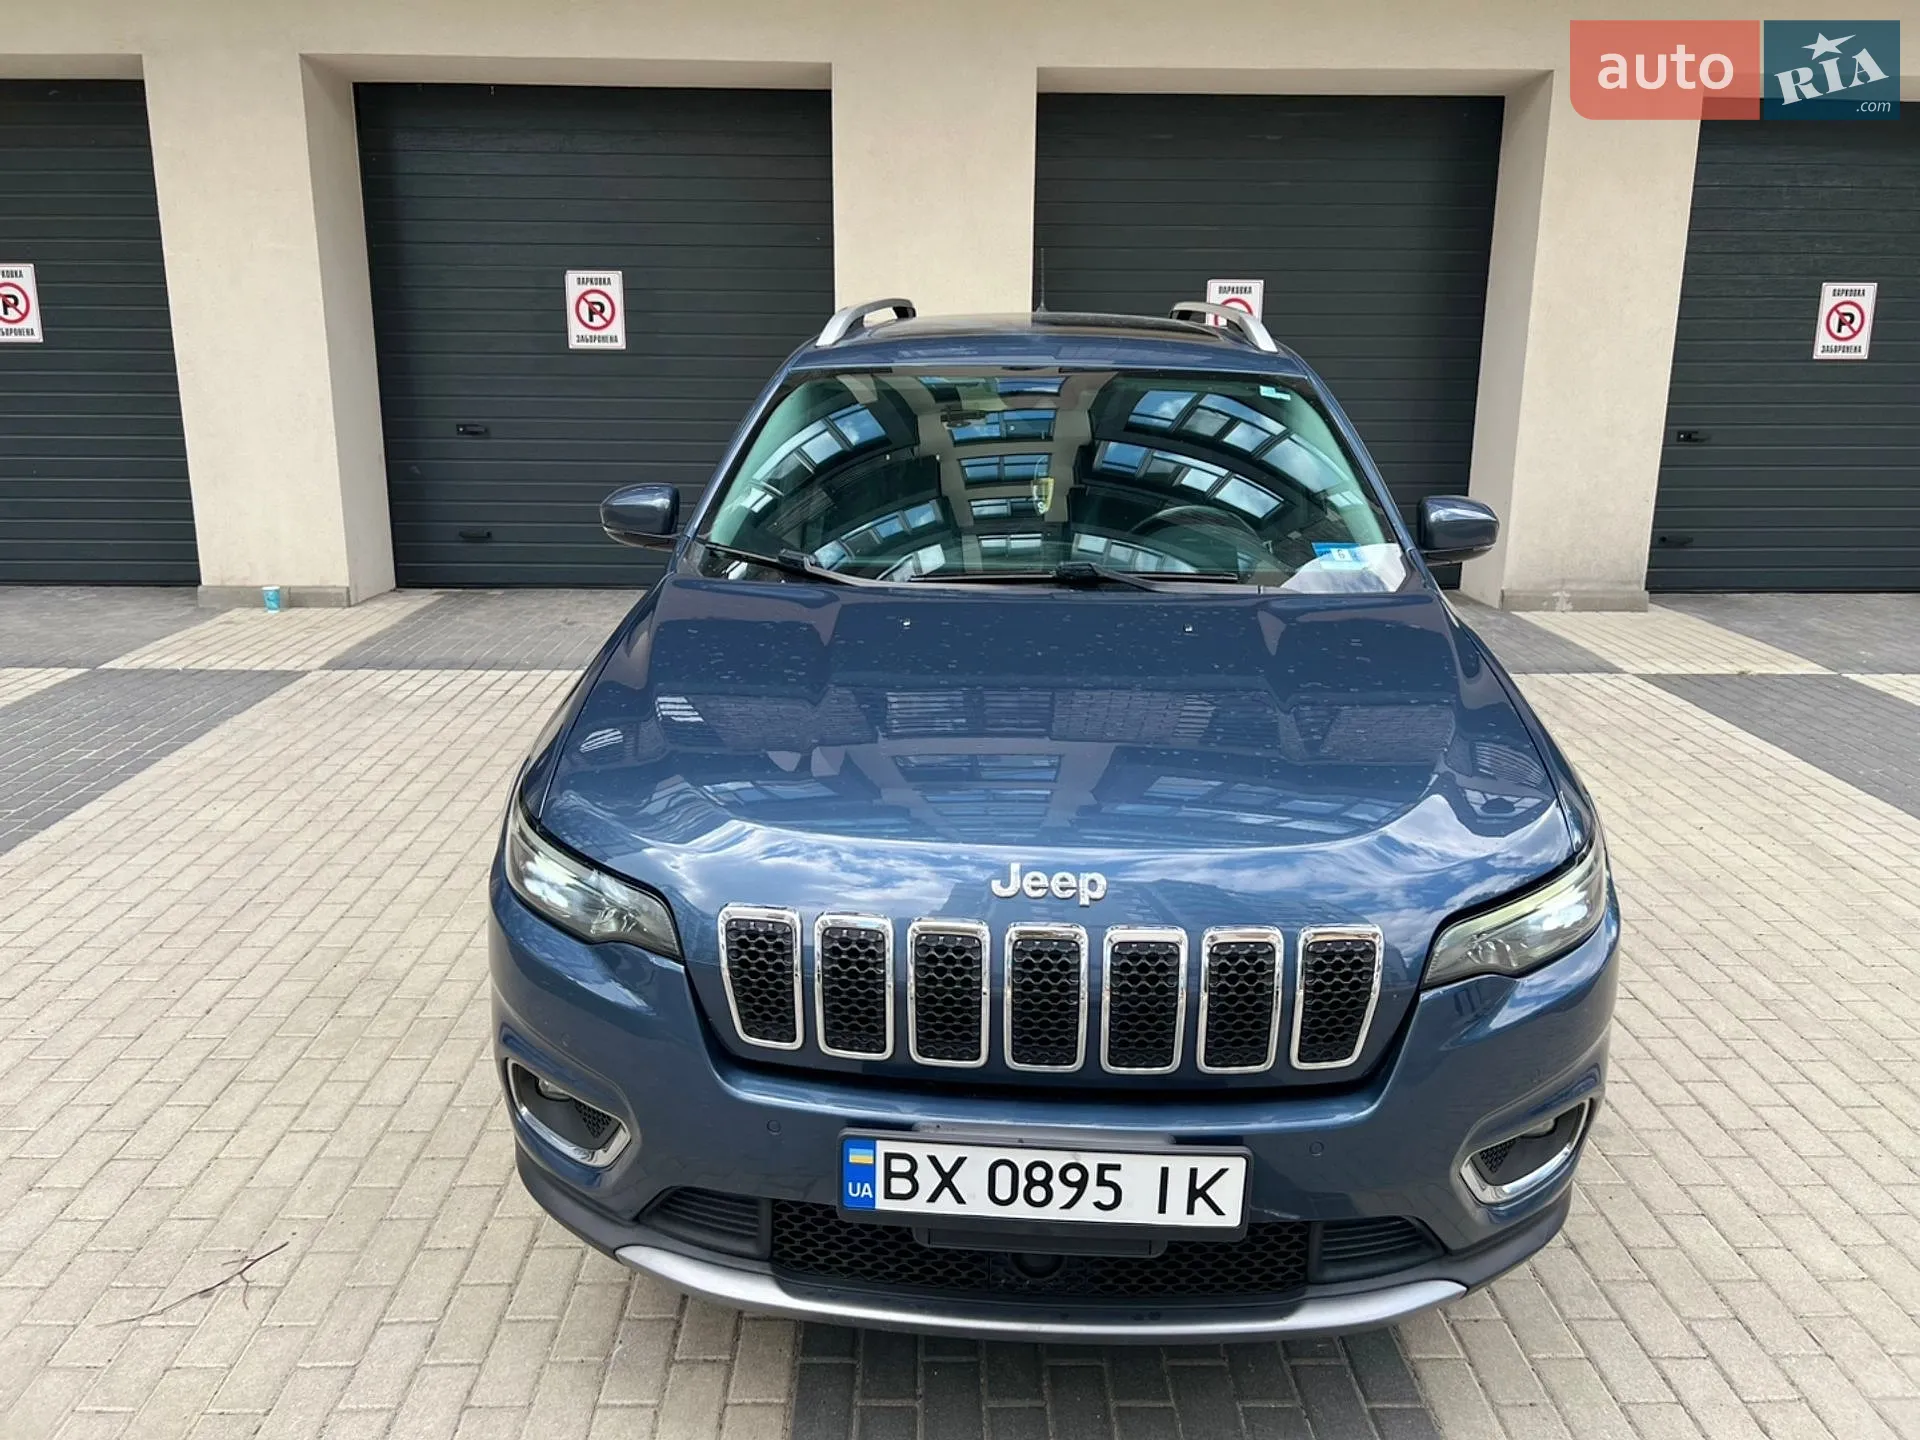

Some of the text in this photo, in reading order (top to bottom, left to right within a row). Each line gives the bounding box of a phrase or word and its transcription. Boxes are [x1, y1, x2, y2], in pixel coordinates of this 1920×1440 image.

[577, 277, 612, 286] ПАРКОВКА
[1832, 288, 1866, 297] ПАРКОВКА
[576, 334, 619, 344] ЗАБОРОНЕНА
[1820, 344, 1862, 354] ЗАБОРОНЕНА
[990, 862, 1108, 907] Jeep
[883, 1151, 1230, 1217] BX 0895 IK
[848, 1182, 873, 1199] UA
